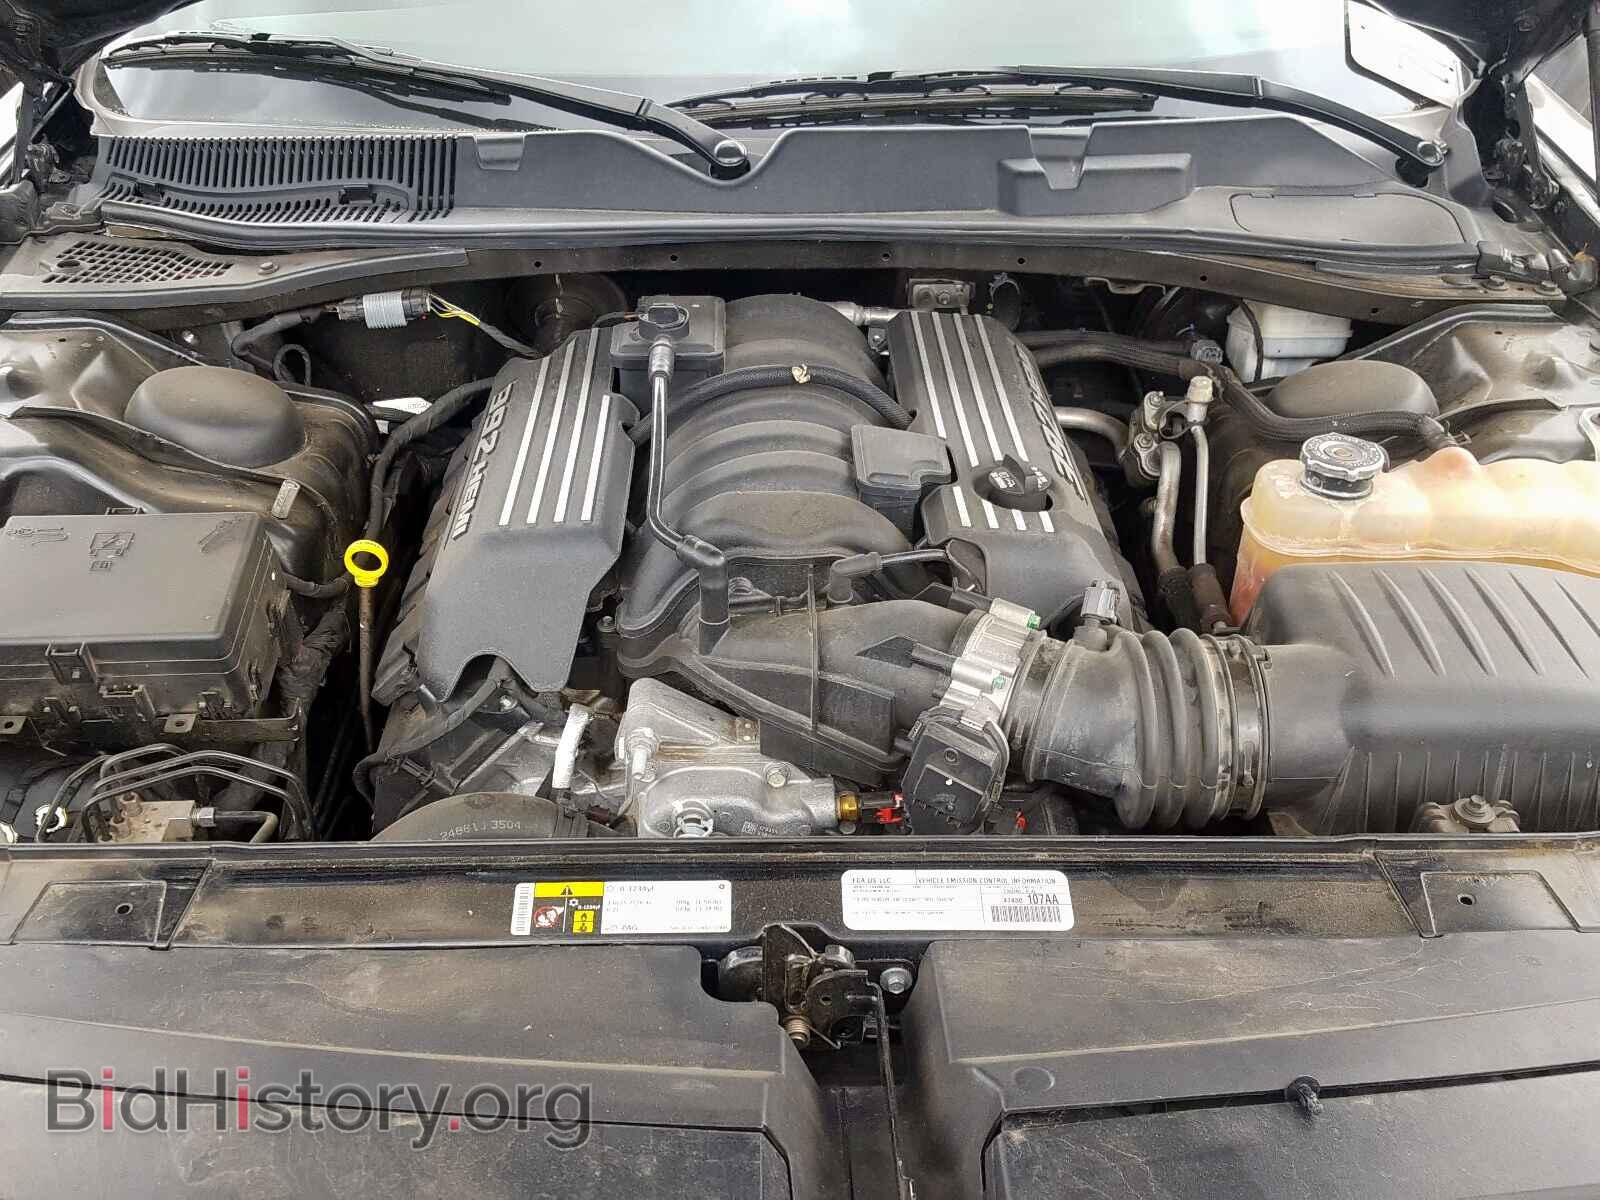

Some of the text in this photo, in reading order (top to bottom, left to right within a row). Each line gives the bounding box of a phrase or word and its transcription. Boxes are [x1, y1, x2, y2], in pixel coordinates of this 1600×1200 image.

[452, 382, 514, 540] 392 HEMI
[1010, 876, 1056, 885] INFORMATION
[1027, 893, 1060, 905] 107AA
